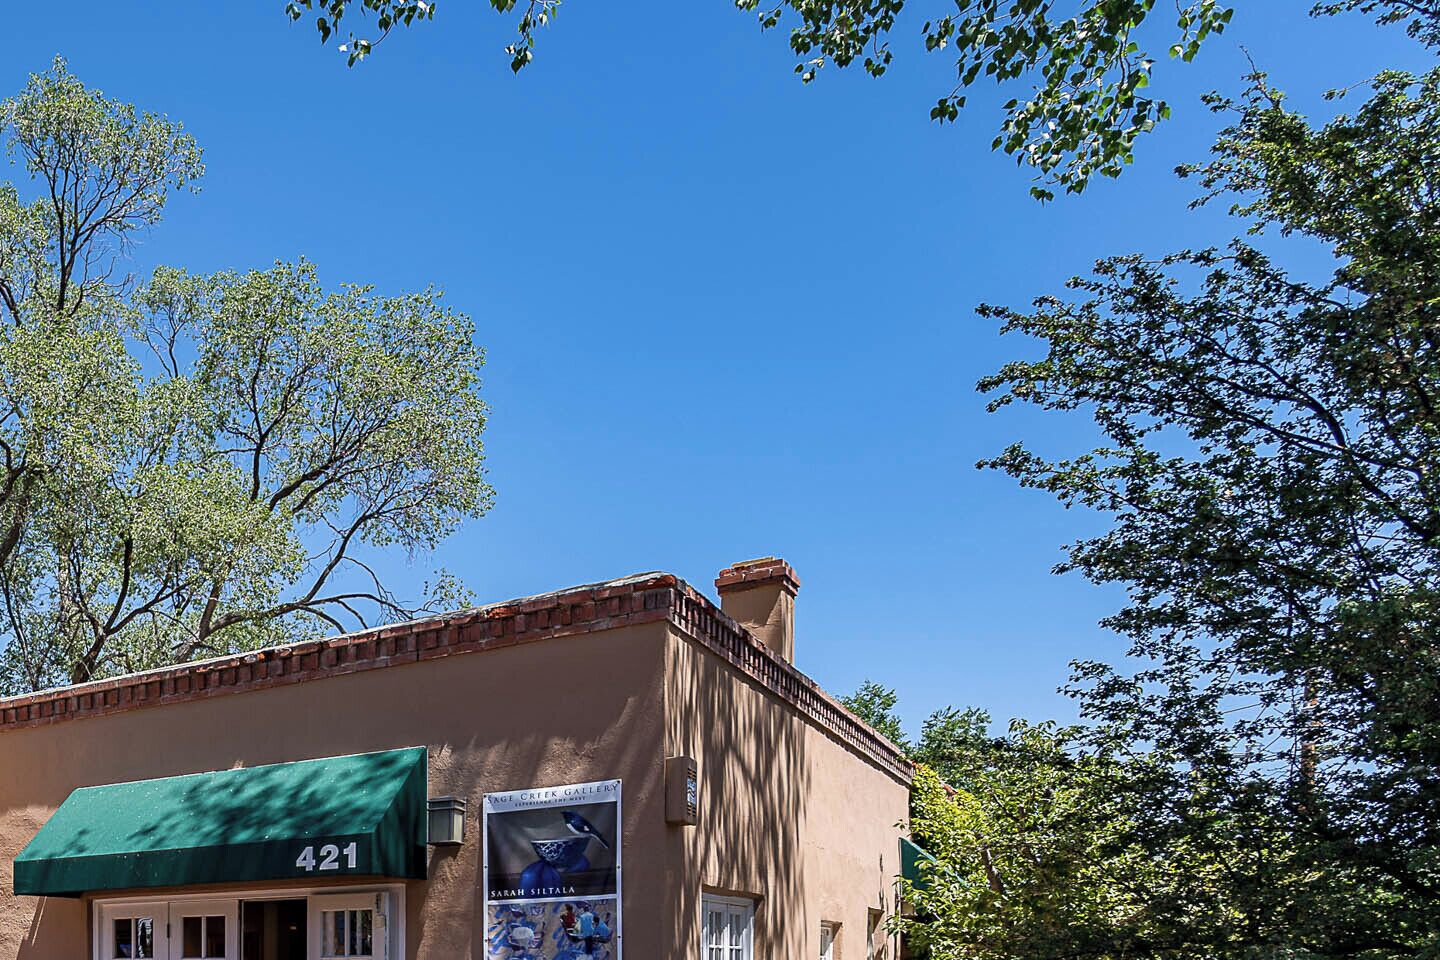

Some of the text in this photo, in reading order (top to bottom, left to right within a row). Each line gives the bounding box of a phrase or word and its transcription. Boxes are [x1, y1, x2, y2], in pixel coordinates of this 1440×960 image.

[487, 784, 618, 804] SAGE CREEK GALLERY
[295, 842, 357, 872] 421
[490, 886, 575, 897] SARAH SILTALA
